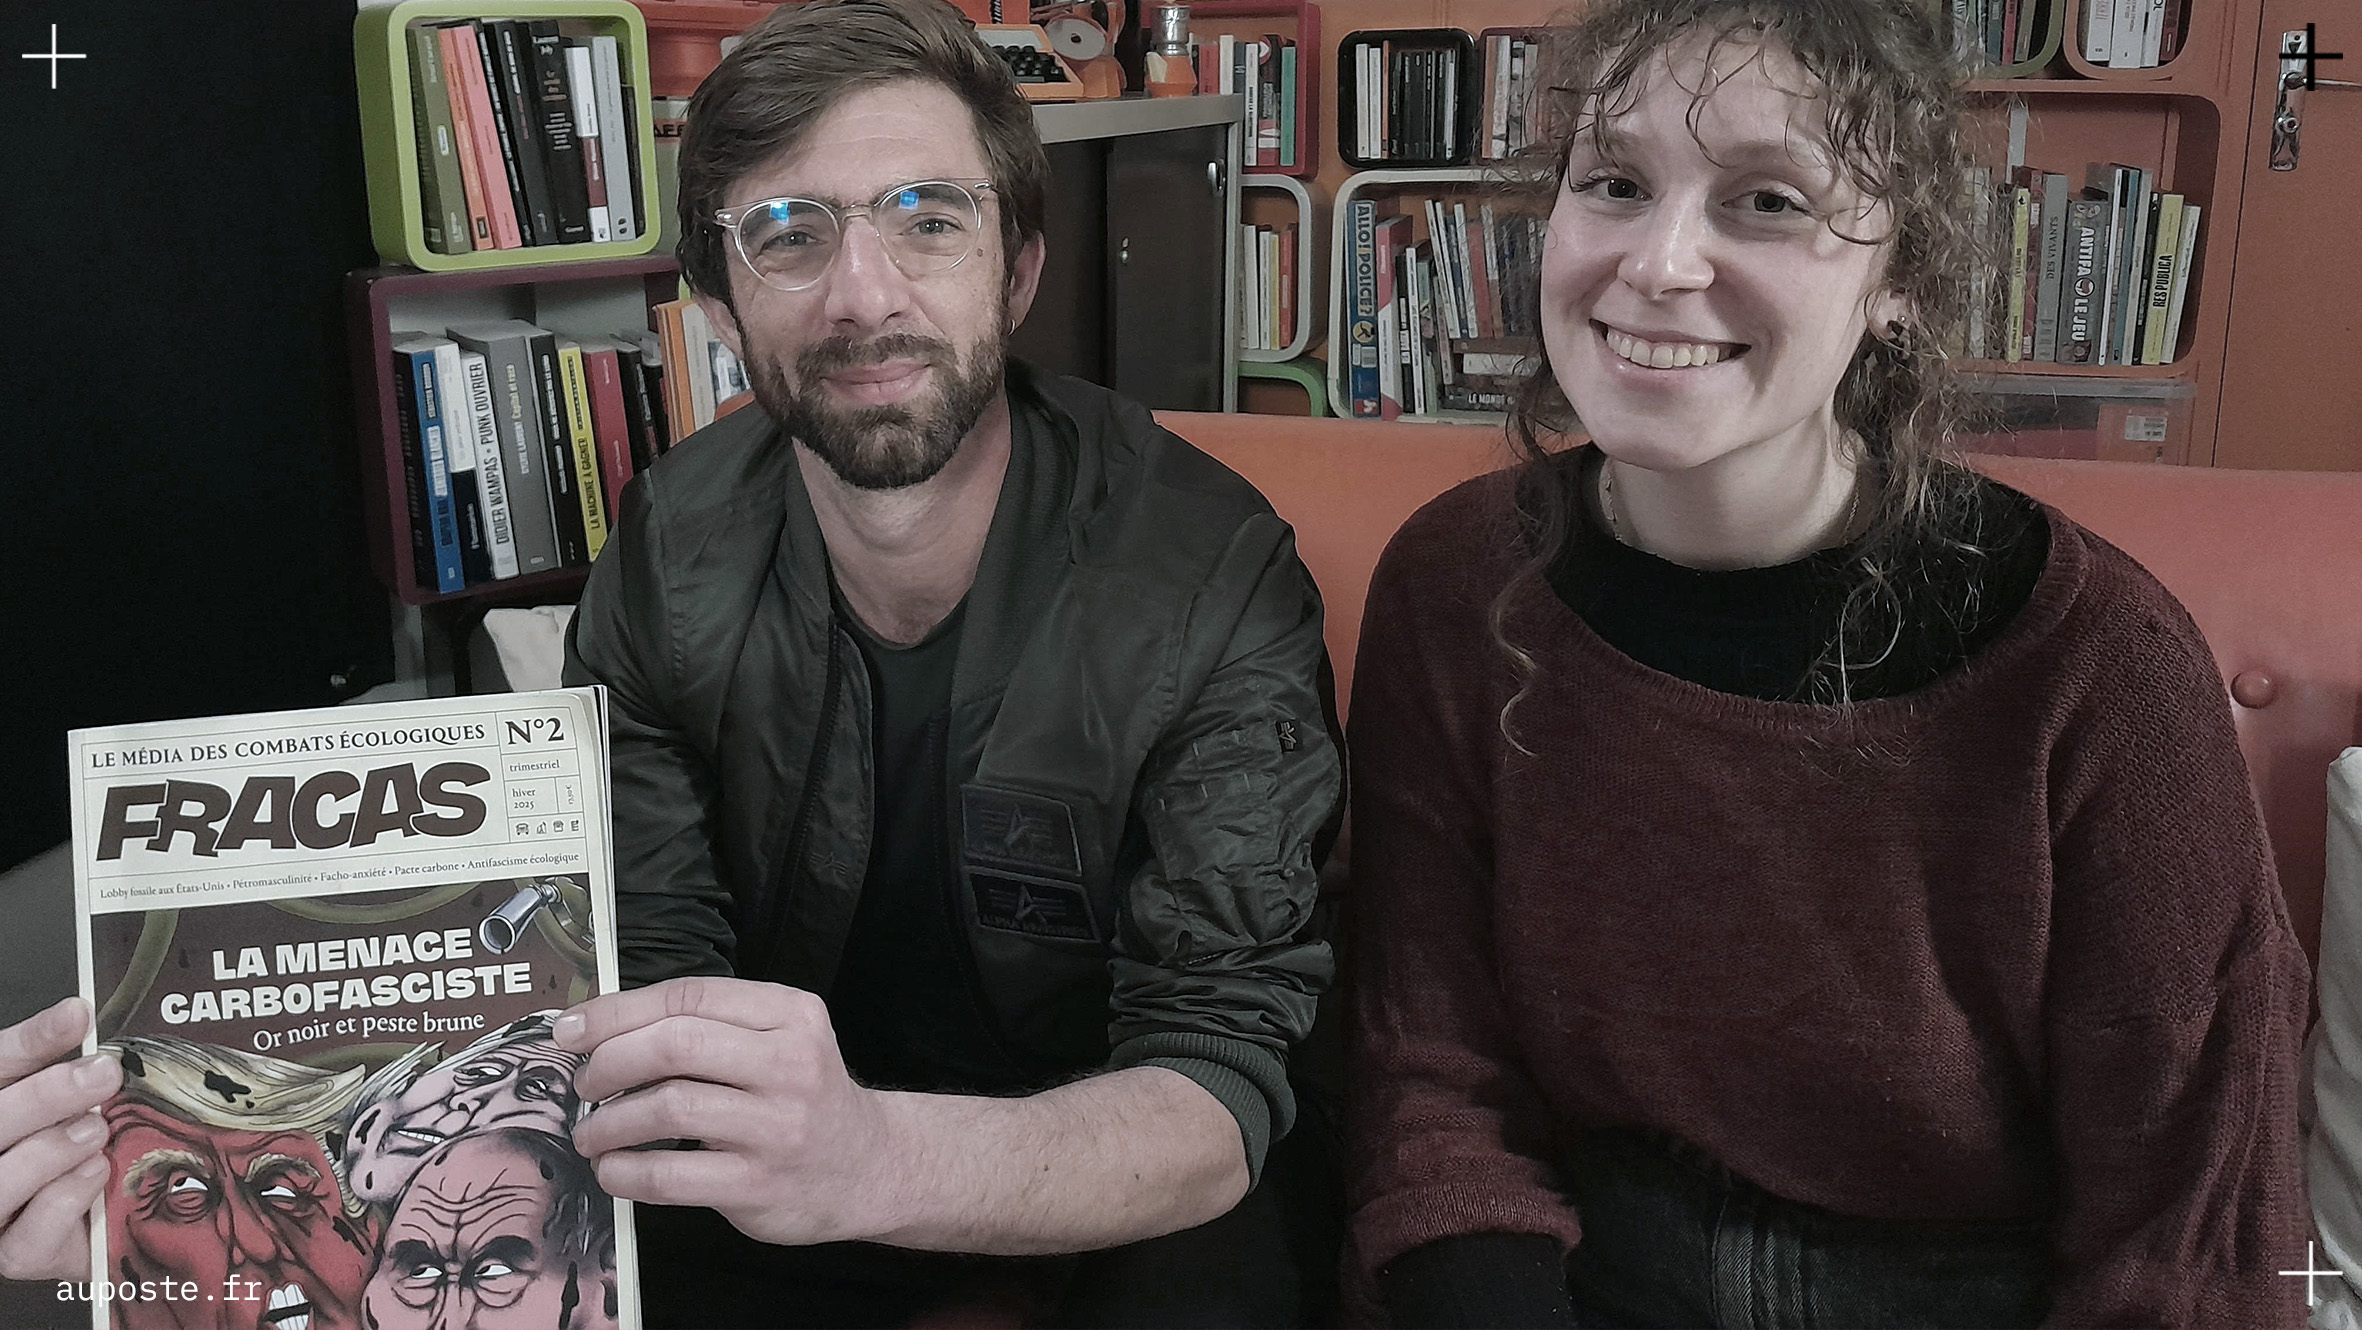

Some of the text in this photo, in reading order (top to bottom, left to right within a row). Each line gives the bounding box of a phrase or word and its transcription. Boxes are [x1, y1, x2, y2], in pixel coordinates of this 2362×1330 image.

[1356, 205, 1374, 316] ALLO! POLICE?
[2045, 216, 2059, 279] DES VIVANTS
[2072, 227, 2094, 341] ANTIFA LE JEU
[2155, 254, 2172, 290] PUBLICA
[2153, 291, 2167, 307] RES
[470, 363, 510, 545] DIDIER WAMPAS PUNK OUVRIER
[575, 437, 590, 470] GAGNER
[583, 479, 598, 516] MACHINE
[589, 516, 600, 529] LA
[92, 724, 485, 768] LE MÉDIA DES COMBATS ÉCOLOGIQUES
[505, 718, 565, 746] N°2
[509, 758, 560, 773] trimestriel
[96, 761, 493, 862] FRACAS
[512, 787, 536, 798] hiver
[513, 801, 535, 811] 2025
[100, 852, 580, 900] Lobby fossile aux États-Unis Pétromasculinité Facho-anxiété Pacte carbone Antifascisme écologique
[212, 928, 474, 981] LA MENACE
[160, 962, 533, 1025] CARBOFASCISTE
[252, 1011, 485, 1052] Or noir et peste brune
